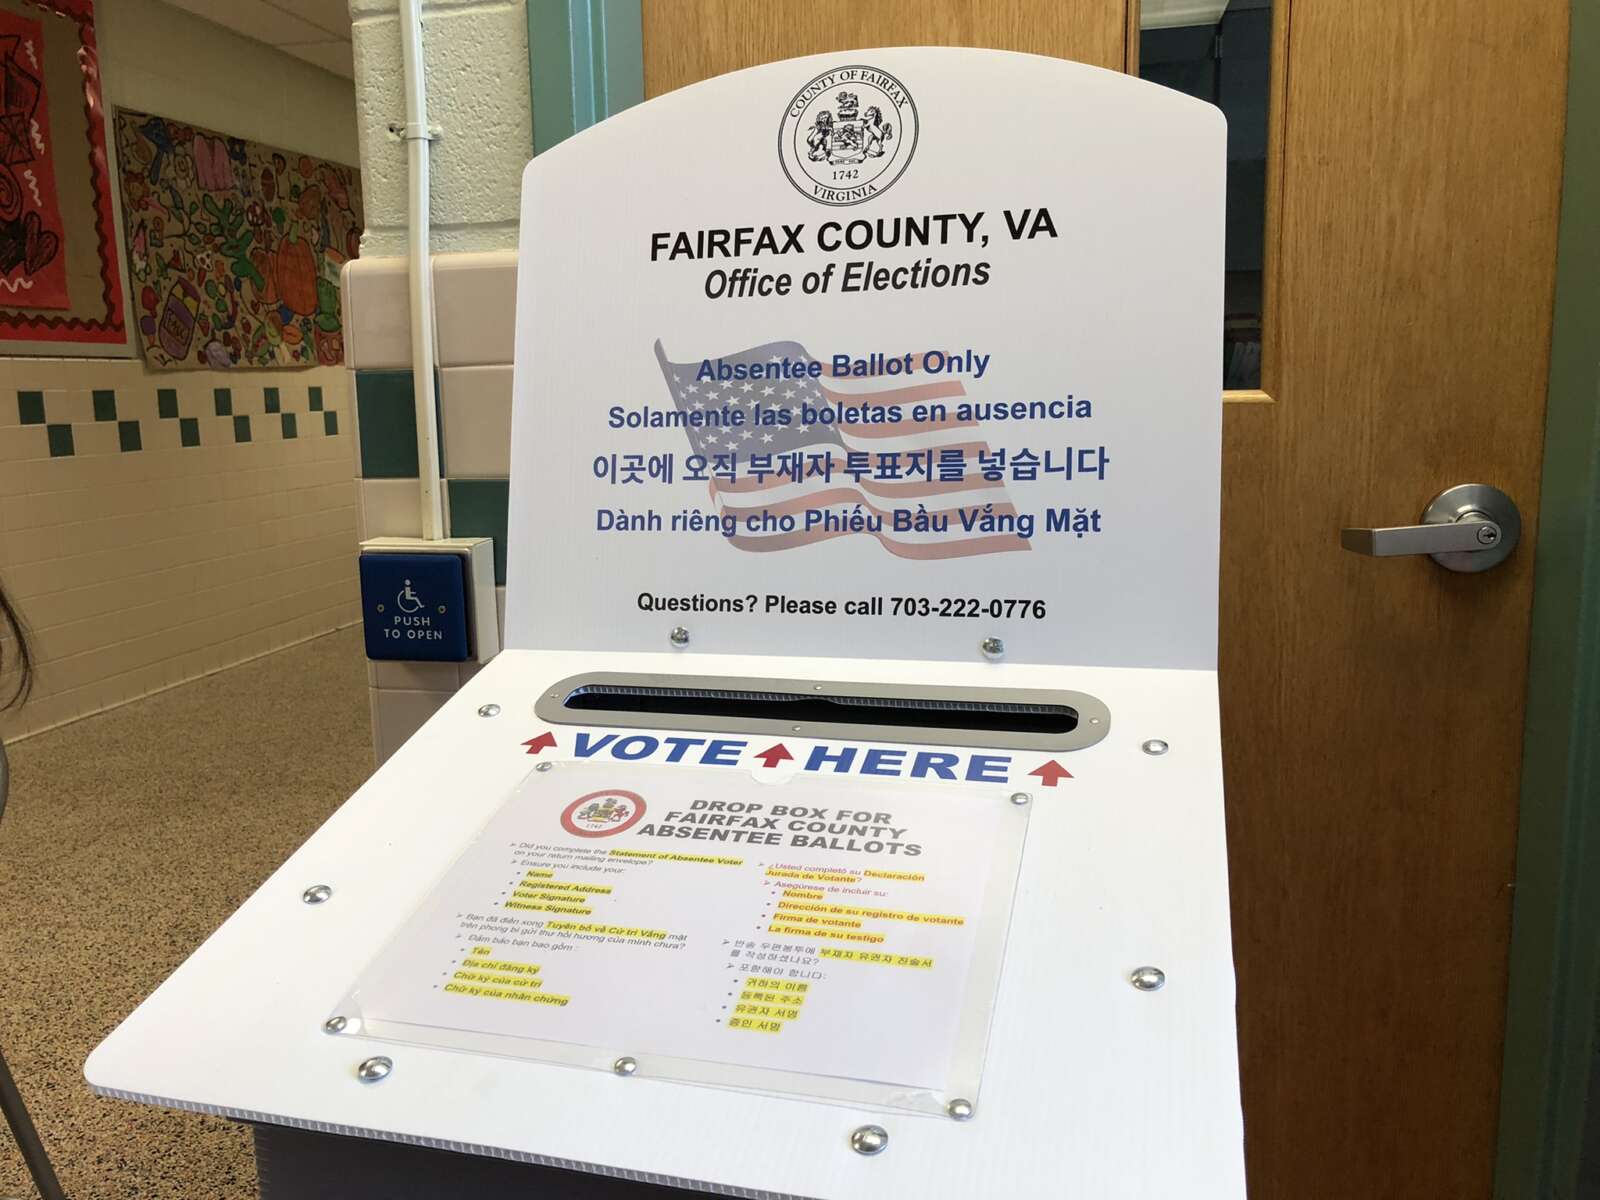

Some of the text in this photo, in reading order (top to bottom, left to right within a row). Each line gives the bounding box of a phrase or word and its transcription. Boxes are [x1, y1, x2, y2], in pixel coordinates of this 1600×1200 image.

[789, 70, 908, 118] COUNTY OF FAIRFAX
[832, 169, 859, 180] 1742
[813, 184, 877, 202] VIRGINIA
[651, 207, 1058, 261] FAIRFAX COUNTY, VA
[705, 258, 991, 299] Office of Elections
[696, 349, 990, 382] Absentee Ballot Only
[608, 394, 1092, 428] Solamente las boletas en ausencia
[593, 446, 1110, 484] 이곳에 오직 부재자 투표지를 넣습니다
[597, 503, 1102, 538] Dành riêng cho Phiếu Bầu Vắng Mặt
[637, 592, 1047, 620] Questions? Please call 703-222-0776
[394, 616, 430, 626] PUSH
[384, 629, 442, 640] TO OPEN
[573, 732, 1015, 785] VOTE HERE
[690, 800, 893, 825] DROP BOX FOR
[664, 811, 908, 840] FAIRFAX COUNTY
[637, 823, 922, 856] ABSENTEE BALLOTS
[553, 845, 592, 854] complete
[609, 849, 656, 859] Statement
[670, 854, 714, 863] Absentee
[575, 855, 606, 863] mailing
[608, 857, 654, 865] envelope?
[526, 870, 554, 878] Name
[570, 864, 602, 872] include
[765, 870, 799, 878] Jurada
[804, 865, 847, 874] completó
[863, 870, 925, 881] Declaración
[519, 881, 612, 894] Registered Address
[783, 890, 823, 899] Nombre
[842, 887, 872, 895] incluir
[539, 892, 586, 903] Signature
[504, 901, 592, 915] Witness Signature
[778, 901, 827, 912] Dirección
[862, 910, 904, 919] registro
[923, 916, 964, 925] votante
[480, 923, 508, 933] phong
[773, 913, 861, 928] Firma de votante
[784, 926, 812, 935] firma
[847, 934, 884, 943] testigo
